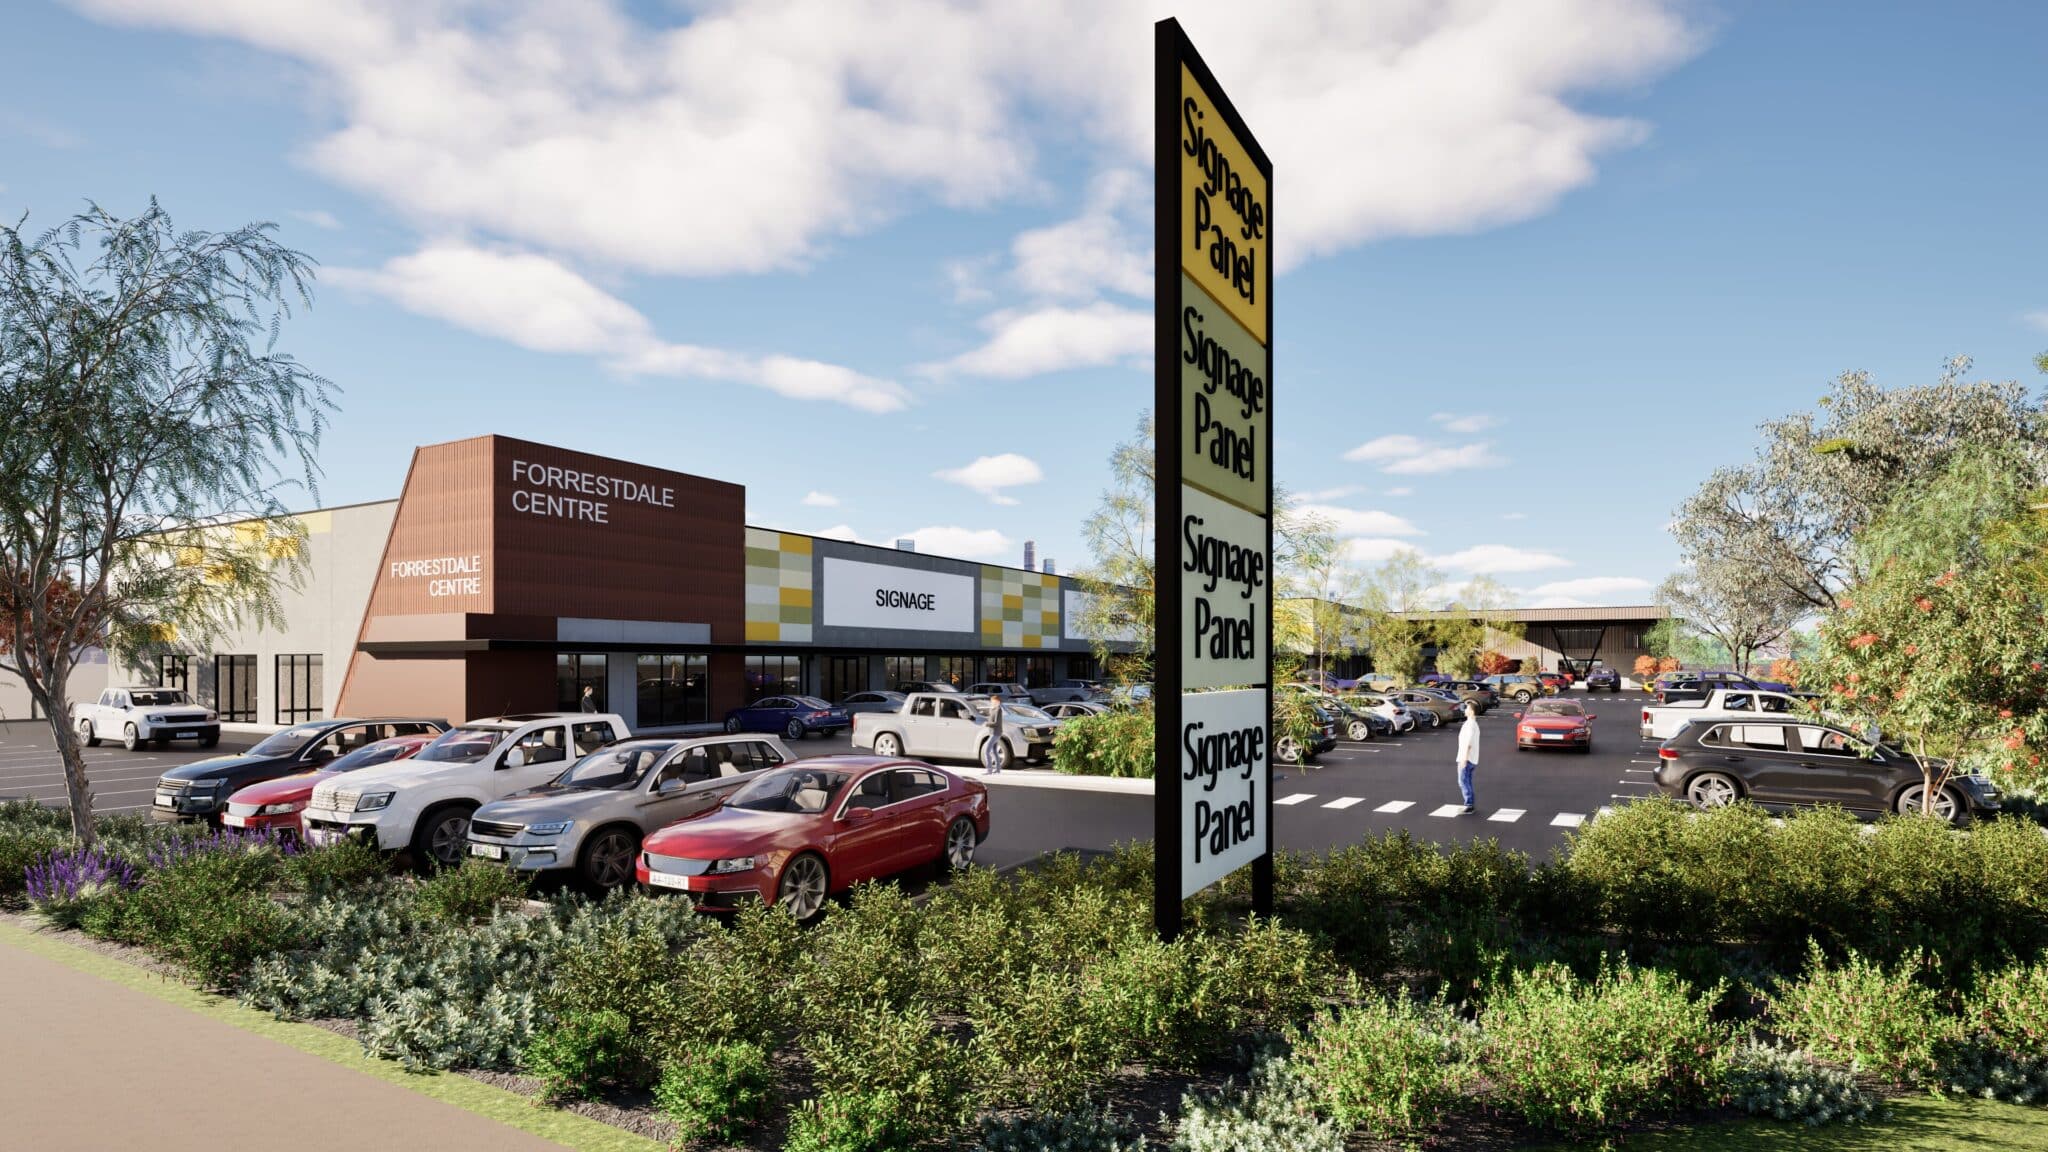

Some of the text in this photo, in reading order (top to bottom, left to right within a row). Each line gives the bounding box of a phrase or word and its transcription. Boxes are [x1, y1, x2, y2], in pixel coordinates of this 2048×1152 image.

[1183, 96, 1264, 240] Signage
[1195, 186, 1255, 305] Panel
[1183, 306, 1264, 420] Signage
[1195, 391, 1255, 482] Panel
[512, 459, 675, 508] FORRESTDALE
[512, 490, 609, 524] CENTRE
[391, 555, 481, 578] FORRESTDALE
[429, 577, 481, 597] CENTRE
[1183, 515, 1264, 599] Signage
[875, 588, 936, 611] SIGNAGE
[1195, 597, 1255, 660] Panel
[1183, 721, 1264, 792] Signage
[1195, 779, 1255, 864] Panel
